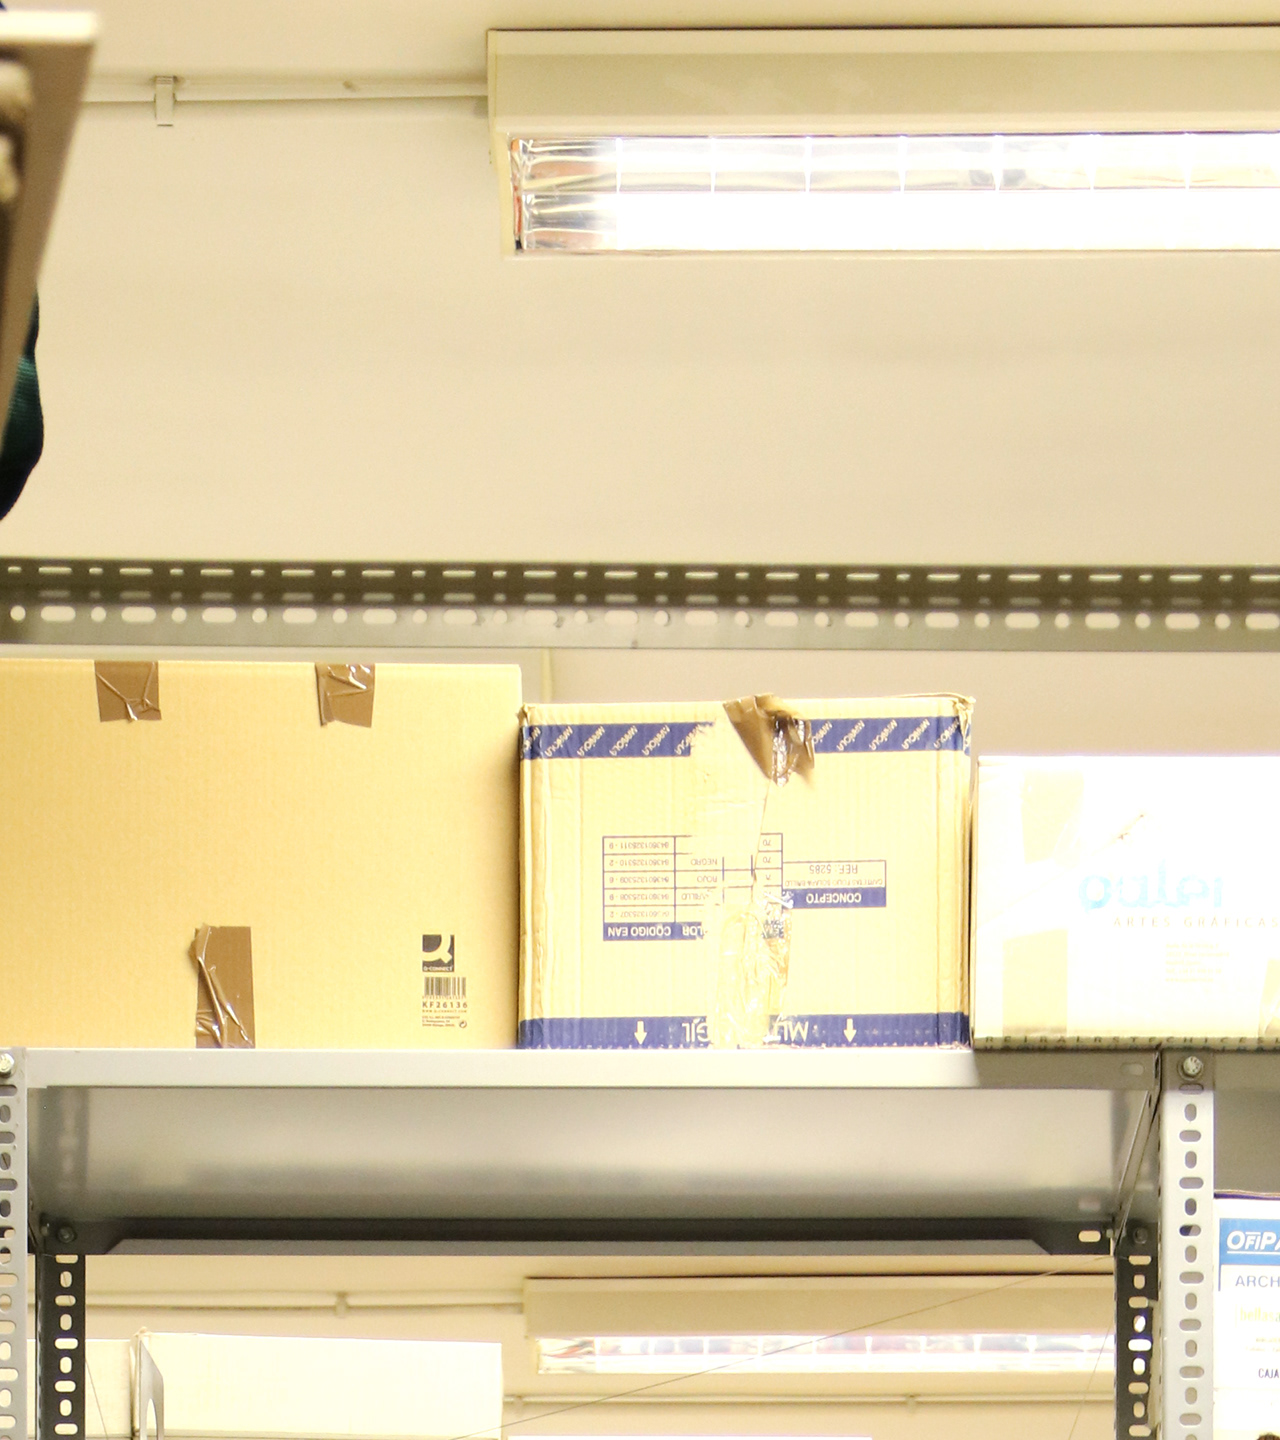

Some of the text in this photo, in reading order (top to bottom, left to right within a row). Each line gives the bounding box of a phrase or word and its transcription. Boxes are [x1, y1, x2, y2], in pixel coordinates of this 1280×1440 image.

[809, 864, 832, 874] 5285
[806, 892, 862, 904] CONCEPTO
[607, 926, 629, 937] EAN
[1258, 1368, 1280, 1379] CAJA
